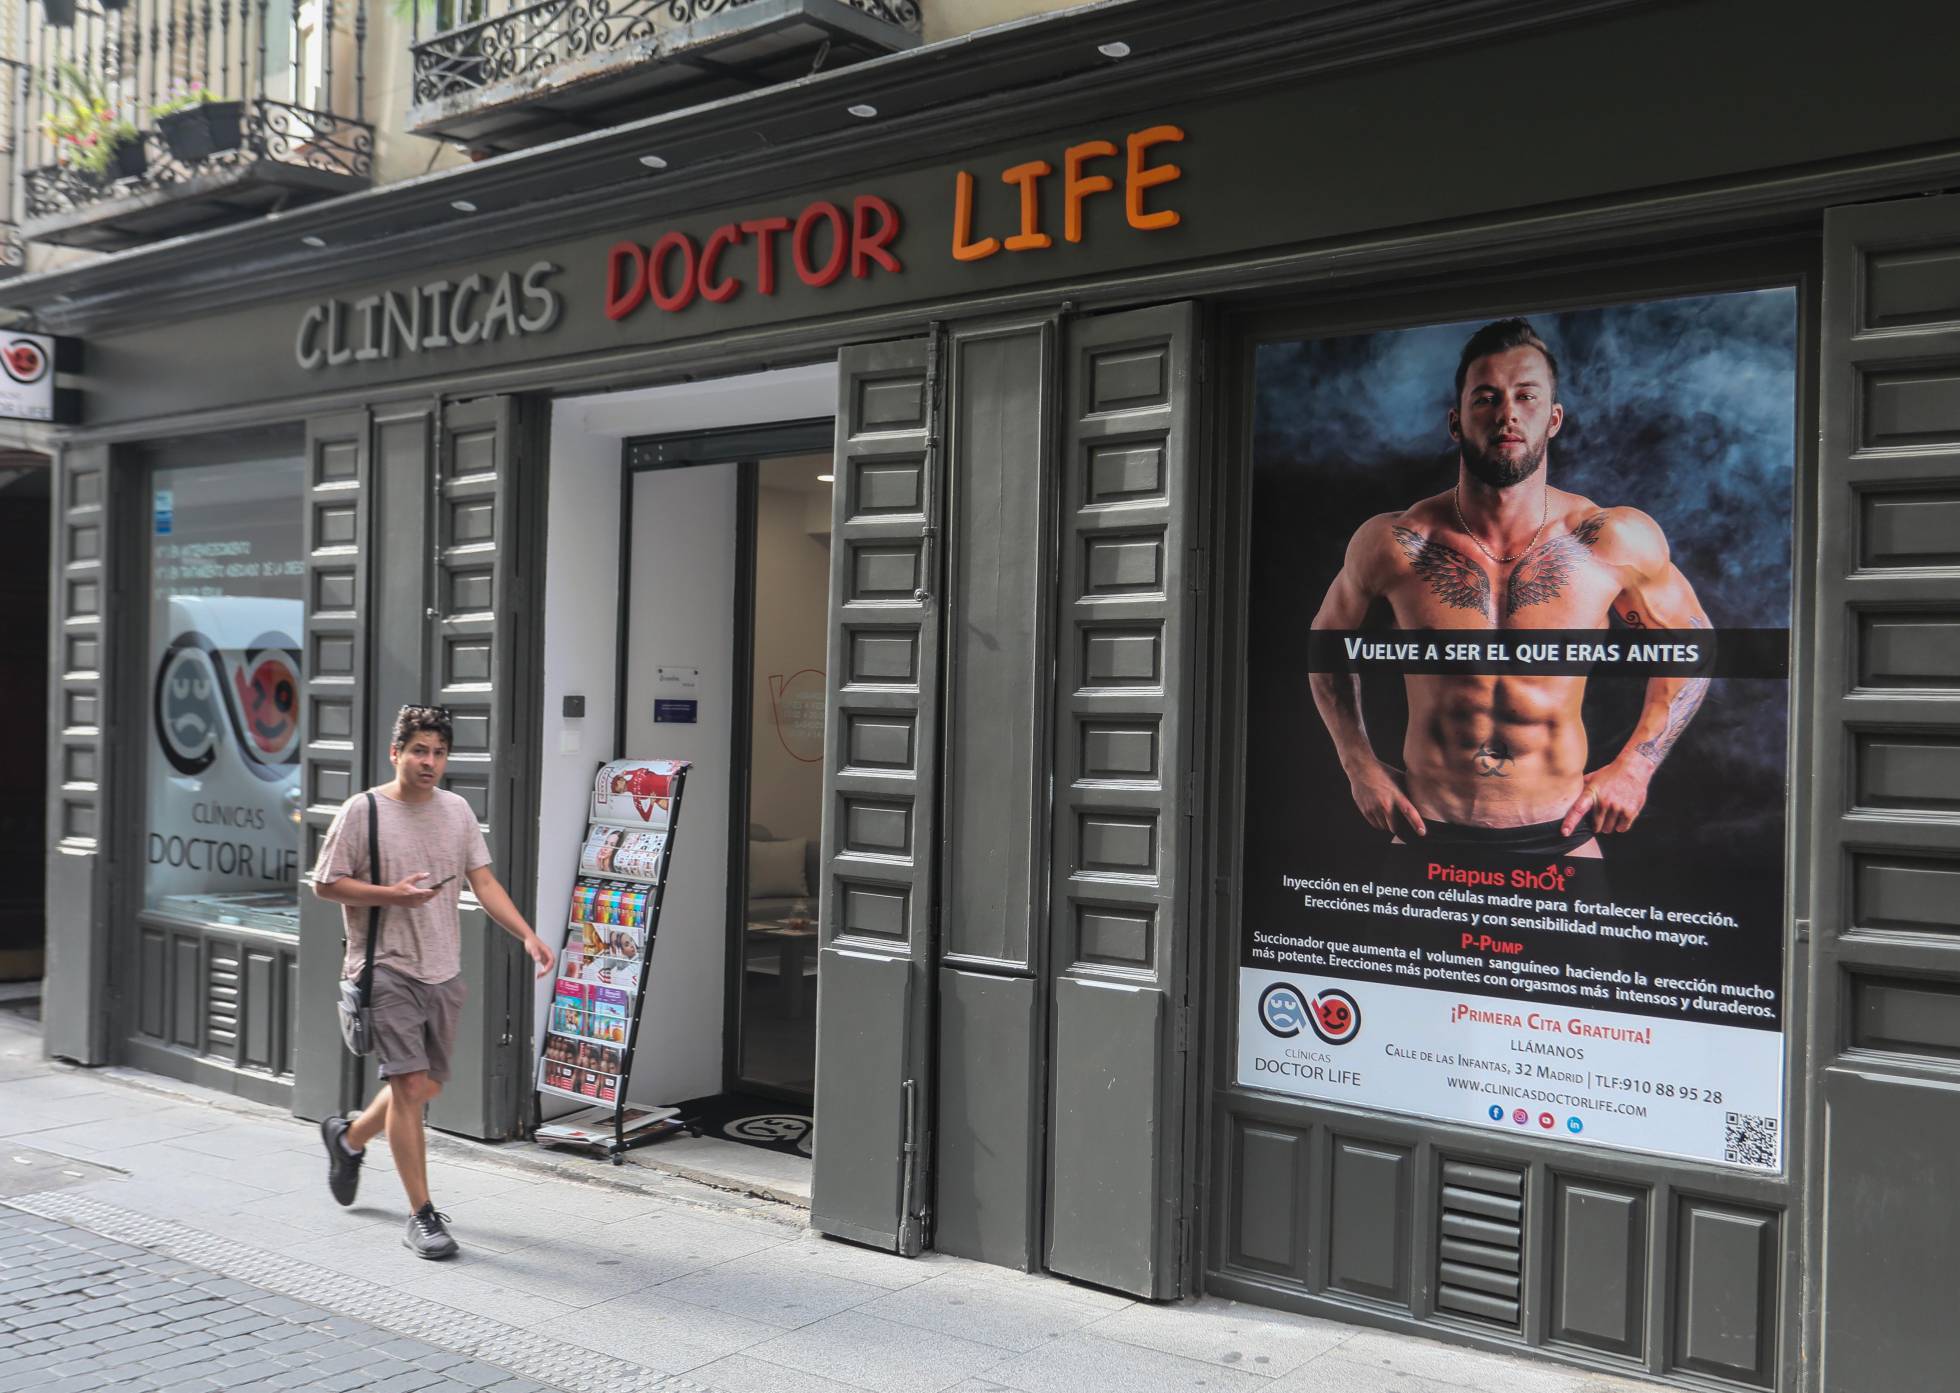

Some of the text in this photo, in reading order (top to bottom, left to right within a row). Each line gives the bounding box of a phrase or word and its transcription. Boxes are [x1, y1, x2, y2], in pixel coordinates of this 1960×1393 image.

[295, 125, 1184, 370] CLINICAS DOCTOR LIFE
[1344, 637, 1699, 664] VUELVE A SER EL QUE ERAS ANTES
[148, 832, 298, 883] DOCTOR LIF
[1428, 863, 1505, 887] Priapus
[1283, 875, 1739, 928] Inyección en el pene con células madre para fortalecer la erección.
[1304, 895, 1709, 947] Erecciónes más duraderas y con sensibilidad mucho mayor.
[1253, 931, 1775, 1000] Succionador que aumenta el volumen sanguíneo haciendo la erección mucho
[1461, 933, 1524, 955] P-PUMP
[1252, 947, 1776, 1019] más potente. Erecciones más potentes con orgasmos más intensos y duraderos.
[1511, 1039, 1584, 1060] LLÁMANOS
[1527, 1013, 1562, 1033] CITA
[1567, 1018, 1652, 1044] GRATUITA!
[1255, 1057, 1361, 1086] DOCTOR LIFE
[1385, 1043, 1417, 1060] CALLE
[1420, 1051, 1433, 1062] DE
[1435, 1053, 1454, 1065] LAS
[1458, 1053, 1511, 1075] INFANTAS,
[1514, 1062, 1532, 1077] 32
[1536, 1065, 1584, 1084] MADRID
[1655, 1083, 1675, 1097] 88
[1679, 1086, 1698, 1101] 95
[1702, 1089, 1723, 1105] 28
